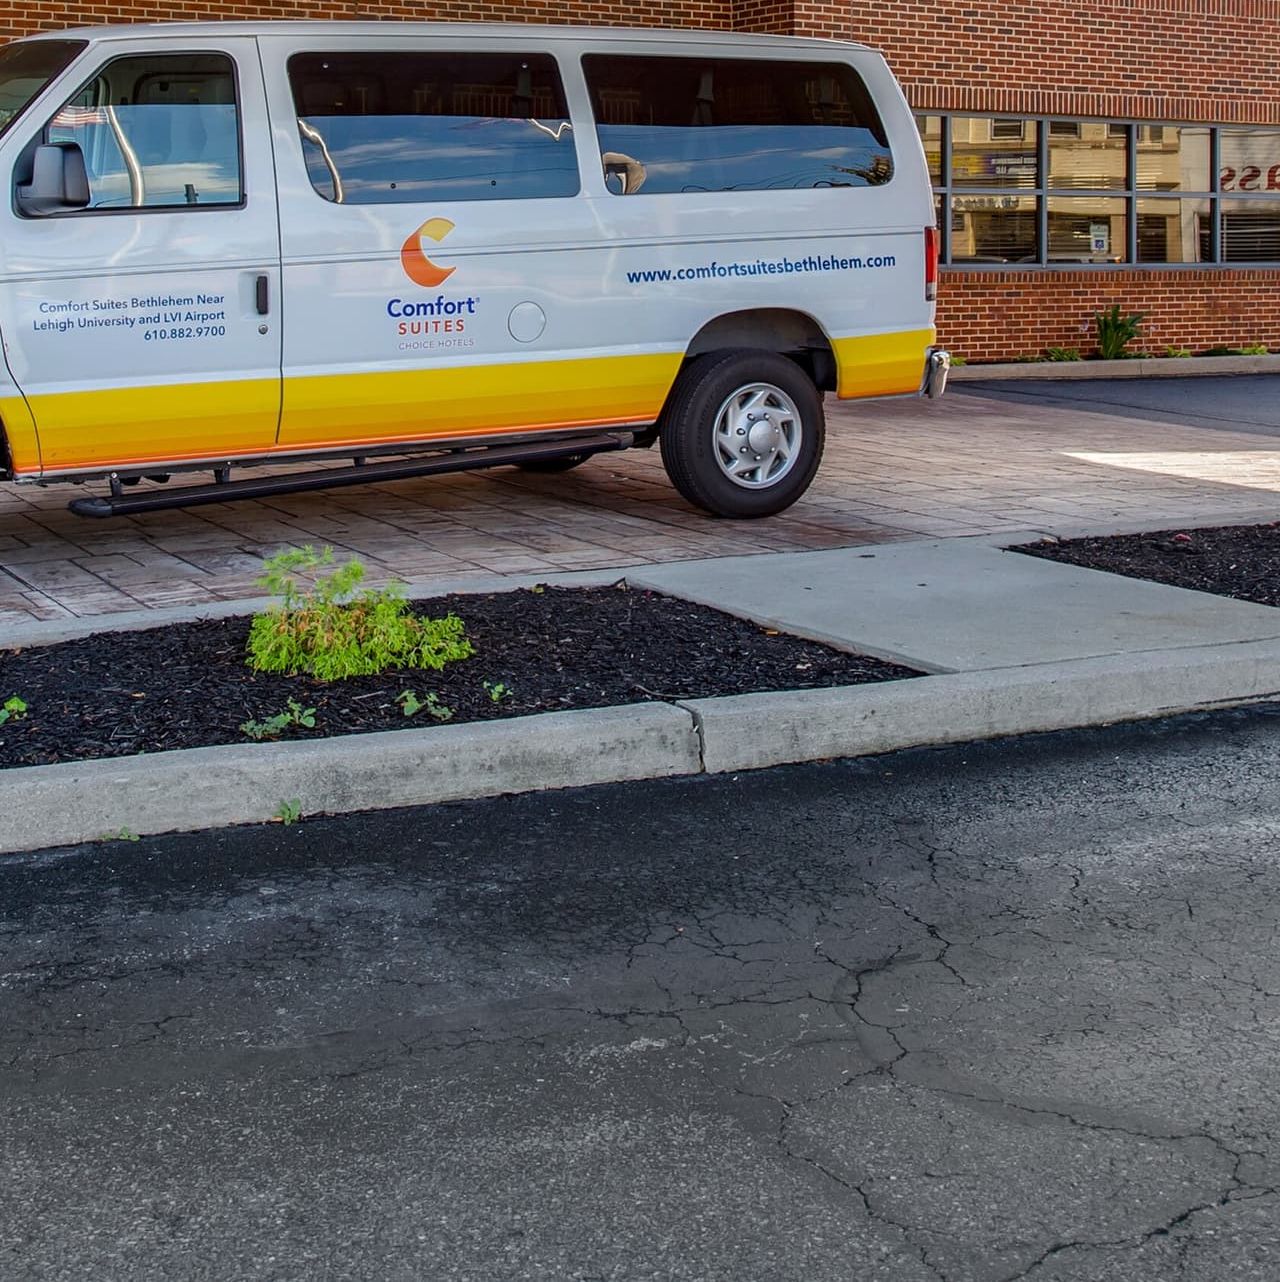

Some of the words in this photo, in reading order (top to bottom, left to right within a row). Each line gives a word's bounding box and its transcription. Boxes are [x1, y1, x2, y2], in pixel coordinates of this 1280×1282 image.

[626, 254, 897, 284] www.comfortsuitesbethlehem.com
[39, 300, 90, 314] Comfort
[92, 298, 128, 311] Suites
[131, 295, 194, 309] Bethlehem
[197, 293, 225, 306] Near
[387, 295, 477, 318] Comfort
[33, 318, 75, 333] Lehigh
[77, 314, 136, 329] University
[138, 312, 161, 325] and
[164, 311, 182, 324] LVI
[184, 310, 225, 323] Airport
[398, 319, 466, 336] SUITES
[144, 325, 226, 341] 610.882.9700
[398, 341, 435, 350] CHOICE
[437, 338, 475, 348] HOTELS
